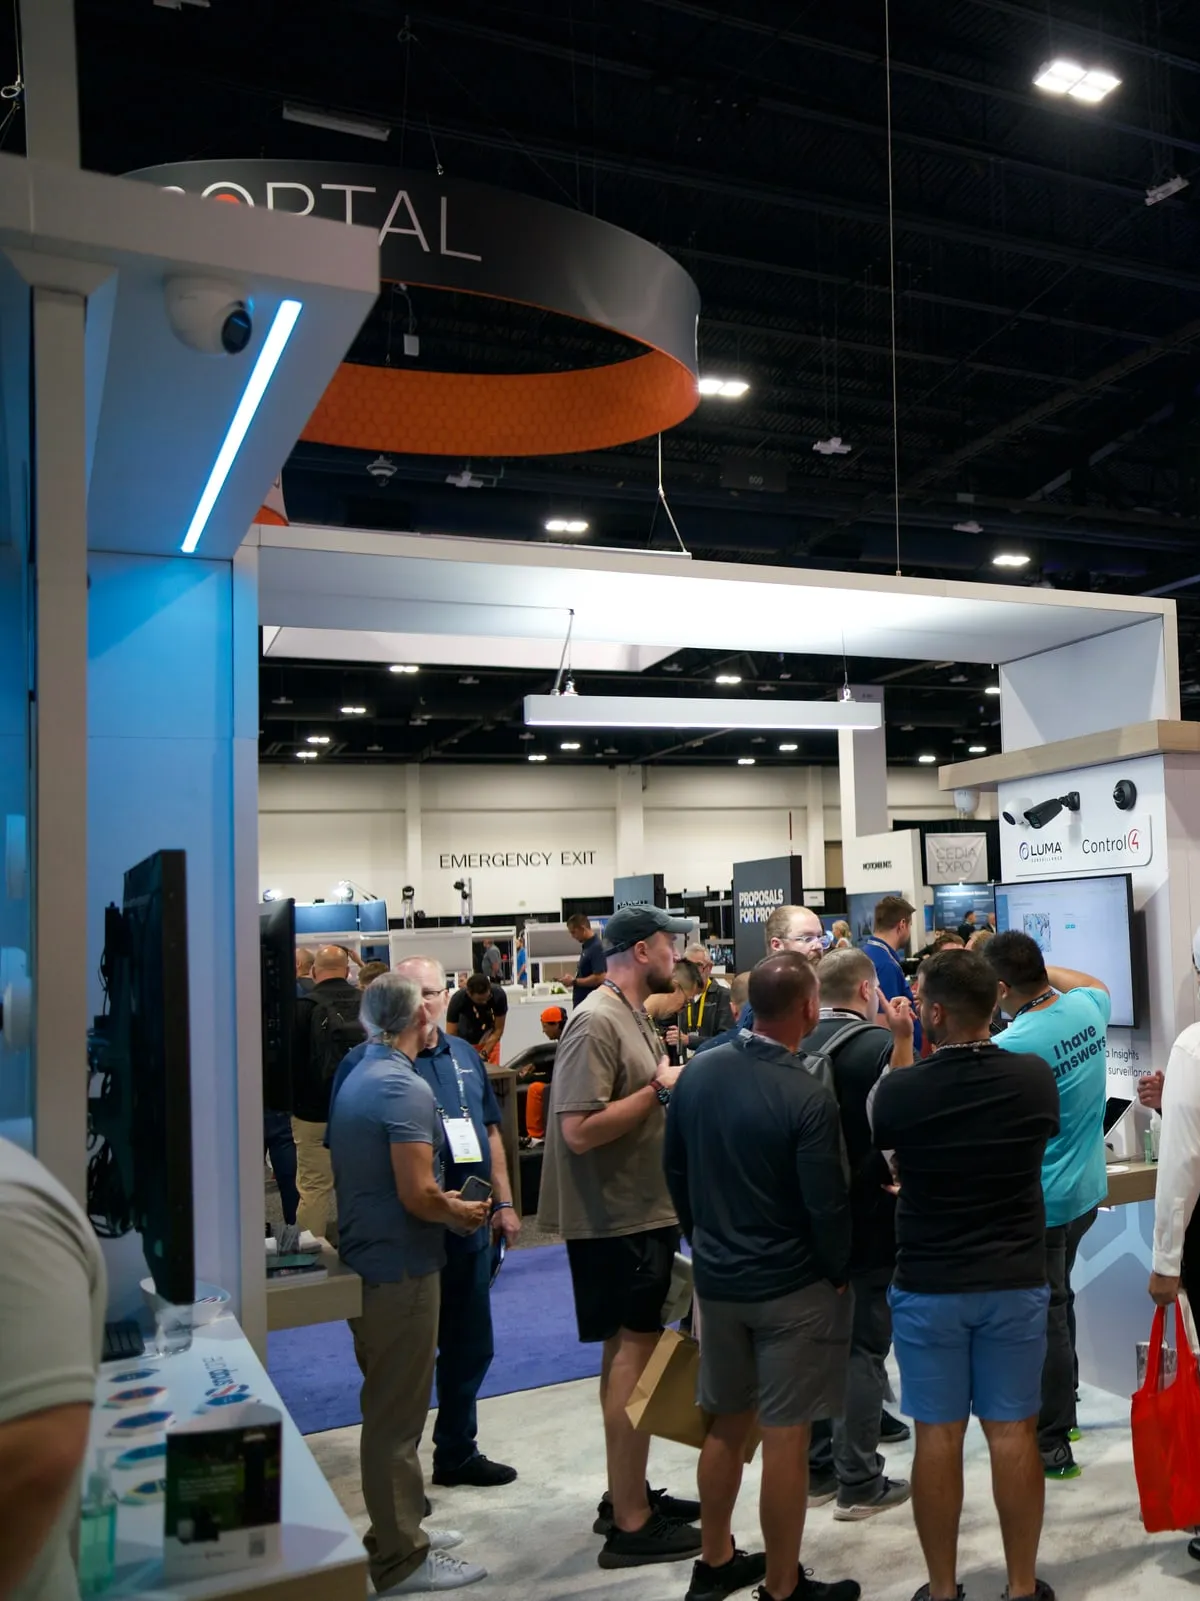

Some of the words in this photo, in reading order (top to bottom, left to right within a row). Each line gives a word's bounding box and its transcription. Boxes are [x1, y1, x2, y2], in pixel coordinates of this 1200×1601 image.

[936, 846, 977, 860] CEDIA
[1030, 841, 1063, 857] LUMA
[439, 851, 553, 869] EMERGENCY
[560, 850, 597, 866] EXIT
[936, 860, 973, 874] EXPO
[739, 888, 784, 907] PROPOSALS
[739, 907, 755, 924] FOR
[1053, 1044, 1062, 1060] I
[1061, 1025, 1096, 1055] have
[1052, 1036, 1106, 1079] answers
[1111, 1048, 1140, 1062] Insights
[1108, 1066, 1152, 1077] surveillance
